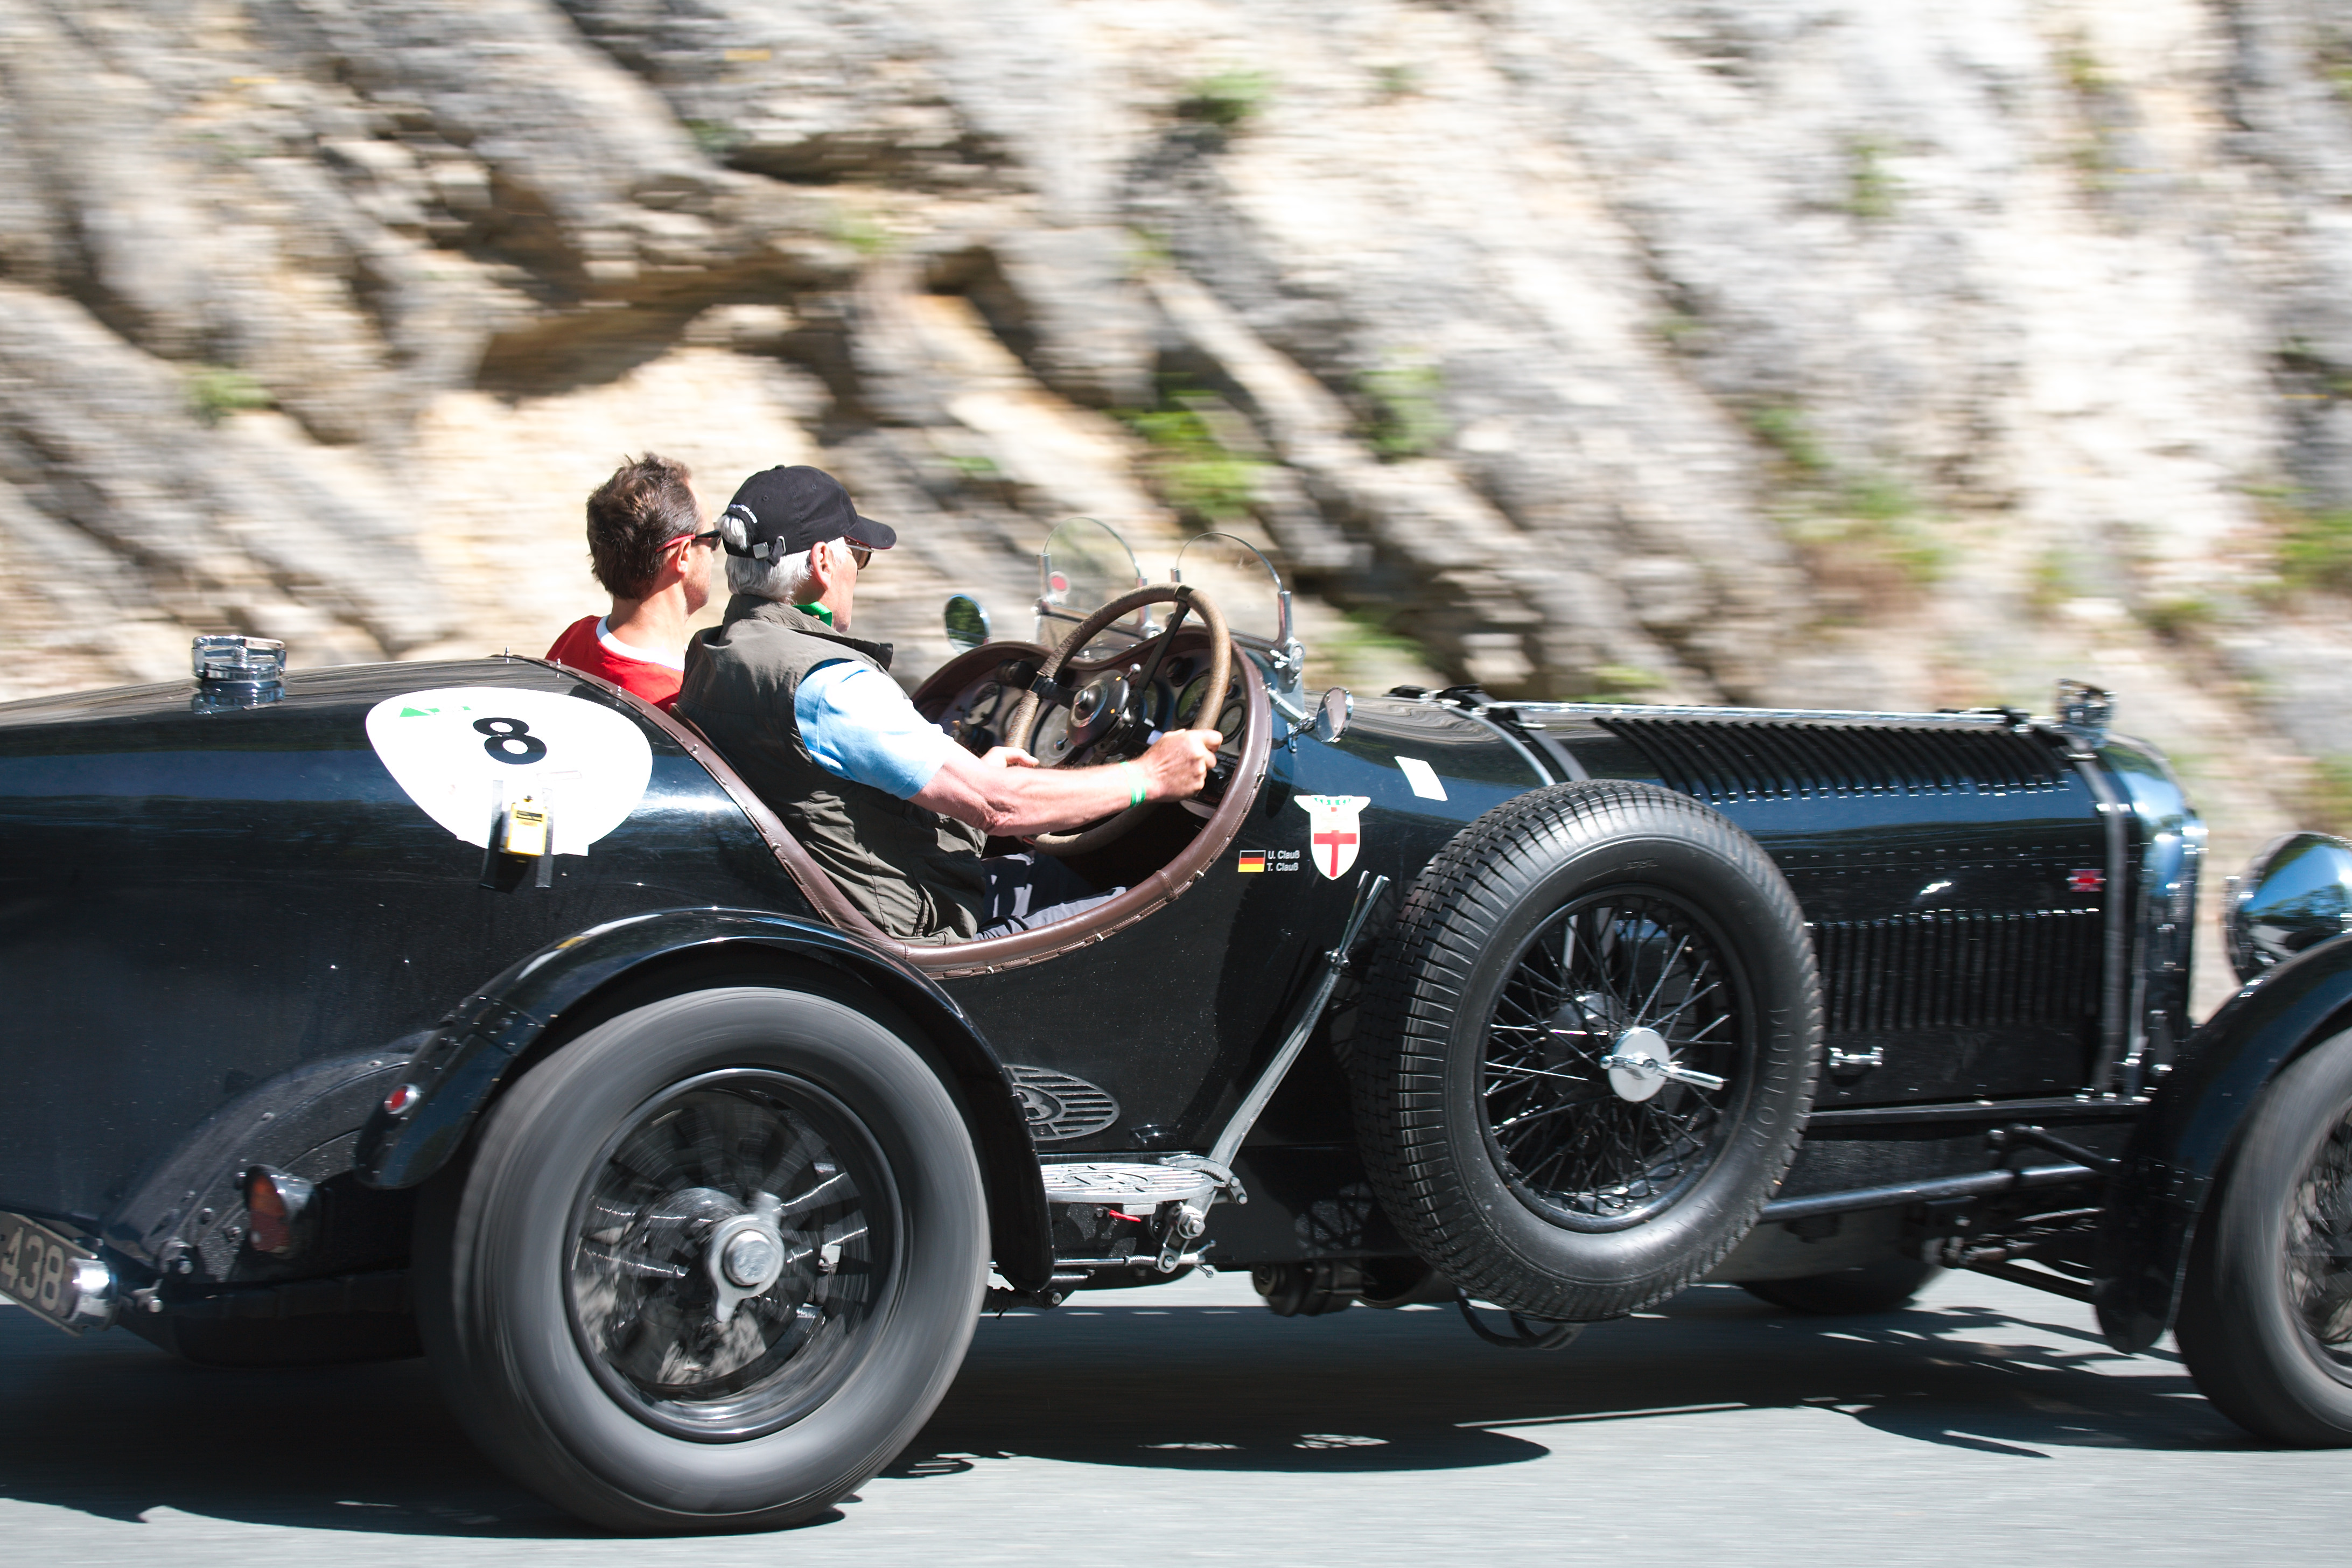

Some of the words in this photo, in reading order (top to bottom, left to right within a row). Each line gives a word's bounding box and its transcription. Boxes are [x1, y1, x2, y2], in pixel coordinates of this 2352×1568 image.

[473, 717, 547, 765] 8
[1266, 863, 1273, 871] T.
[1268, 850, 1276, 859] U.
[1750, 1007, 1794, 1147] DUNLOP
[2, 1227, 64, 1311] 438
